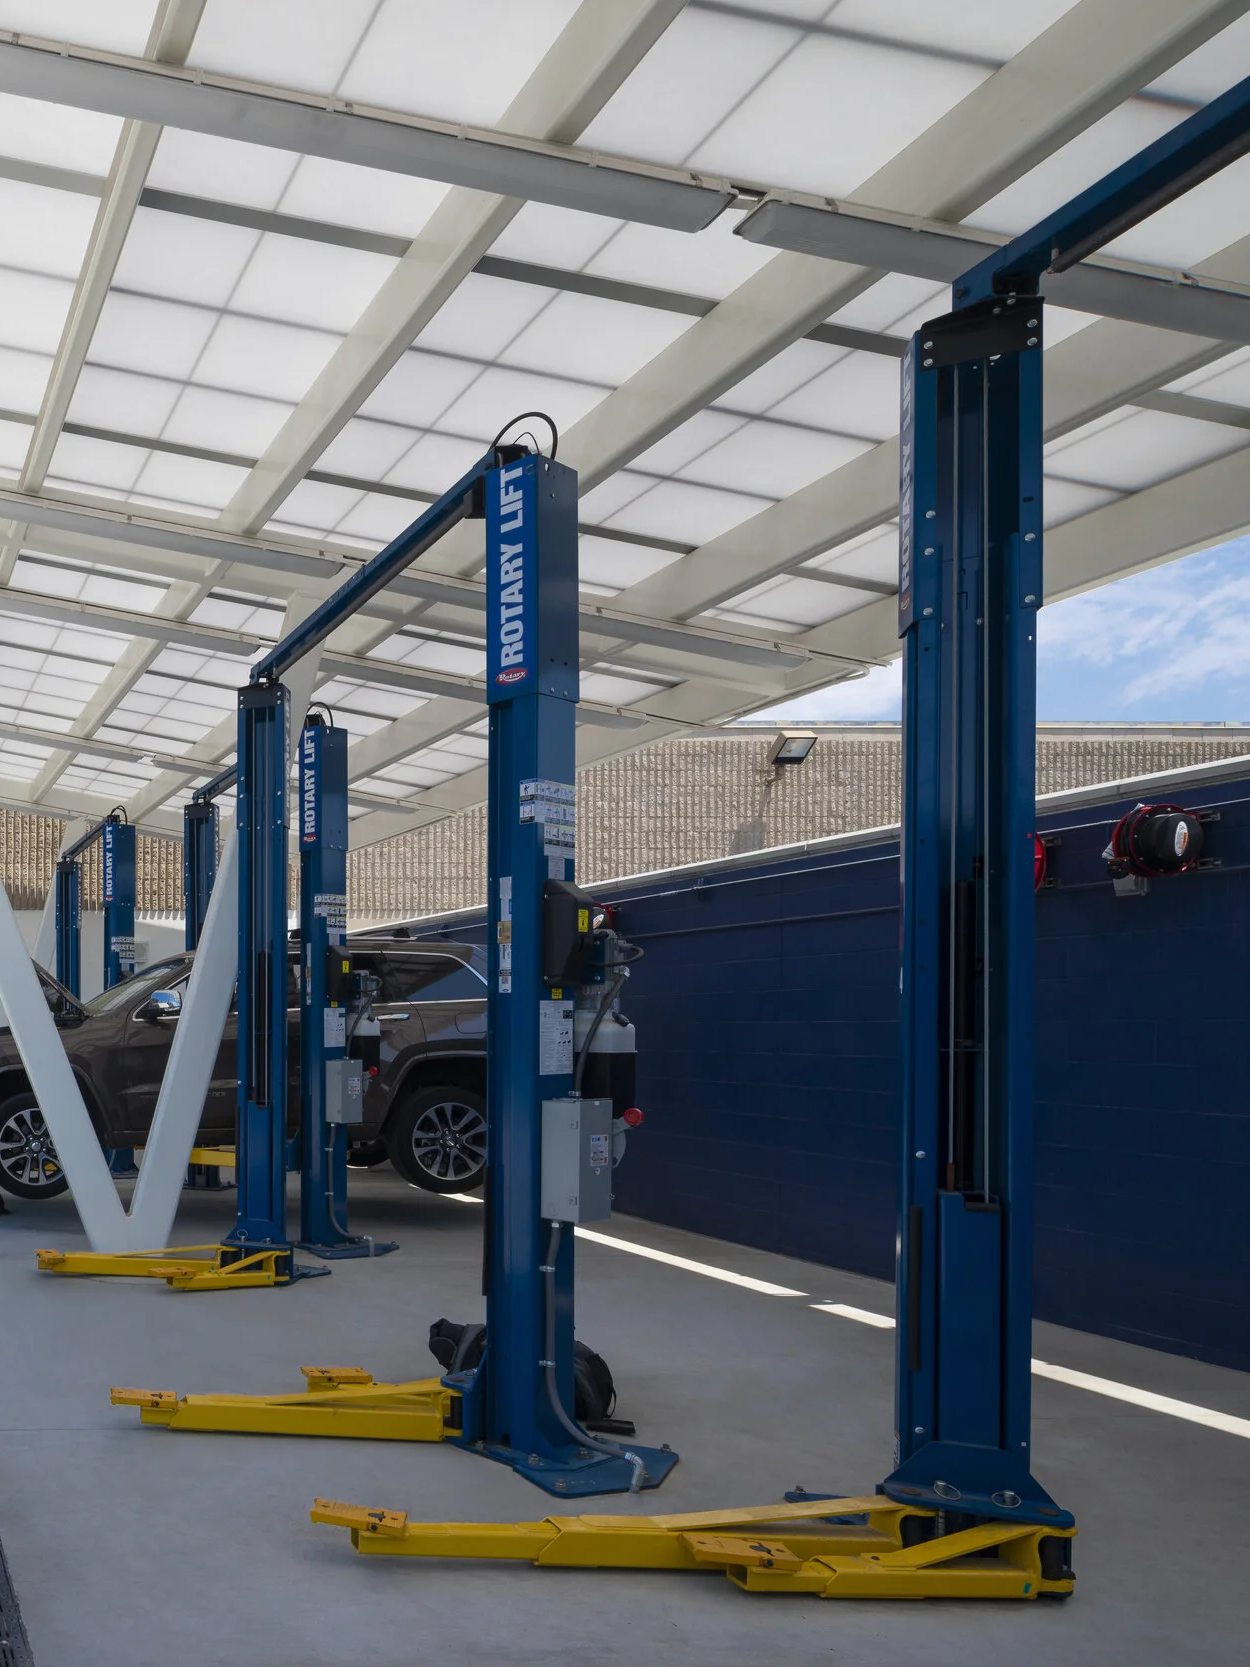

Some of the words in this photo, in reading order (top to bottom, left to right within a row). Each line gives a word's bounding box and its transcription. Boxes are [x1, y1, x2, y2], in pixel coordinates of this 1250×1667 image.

[500, 464, 524, 534] LIFT
[500, 542, 524, 668] ROTARY
[304, 730, 315, 764] LIFT
[304, 769, 316, 834] ROTARY
